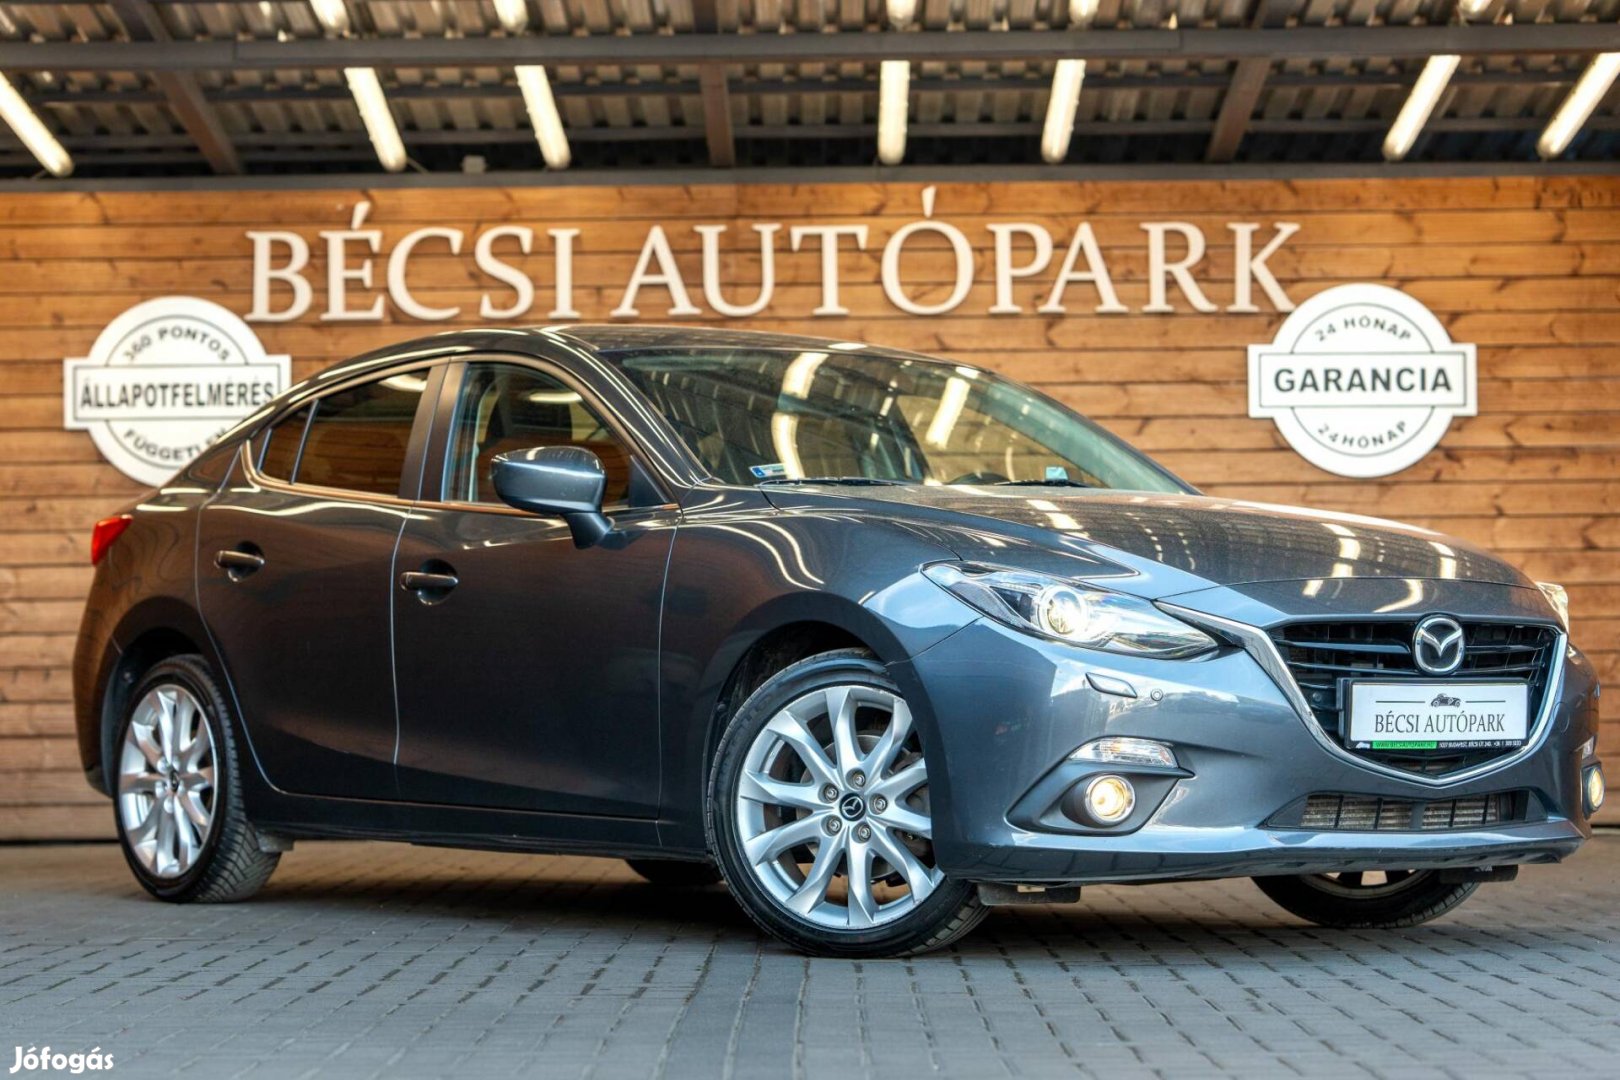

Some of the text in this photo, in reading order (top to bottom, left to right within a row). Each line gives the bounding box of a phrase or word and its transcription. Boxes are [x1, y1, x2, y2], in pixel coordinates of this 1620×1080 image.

[244, 186, 1302, 323] BÉCSI AUTÓPARK
[157, 325, 231, 361] PONTOS
[1314, 323, 1337, 343] 24
[80, 375, 275, 409] ÁLLAPOTFELMÉRÉS
[1273, 367, 1453, 393] GARANCIA
[1374, 710, 1506, 733] BÉCSI AUTÓPARK
